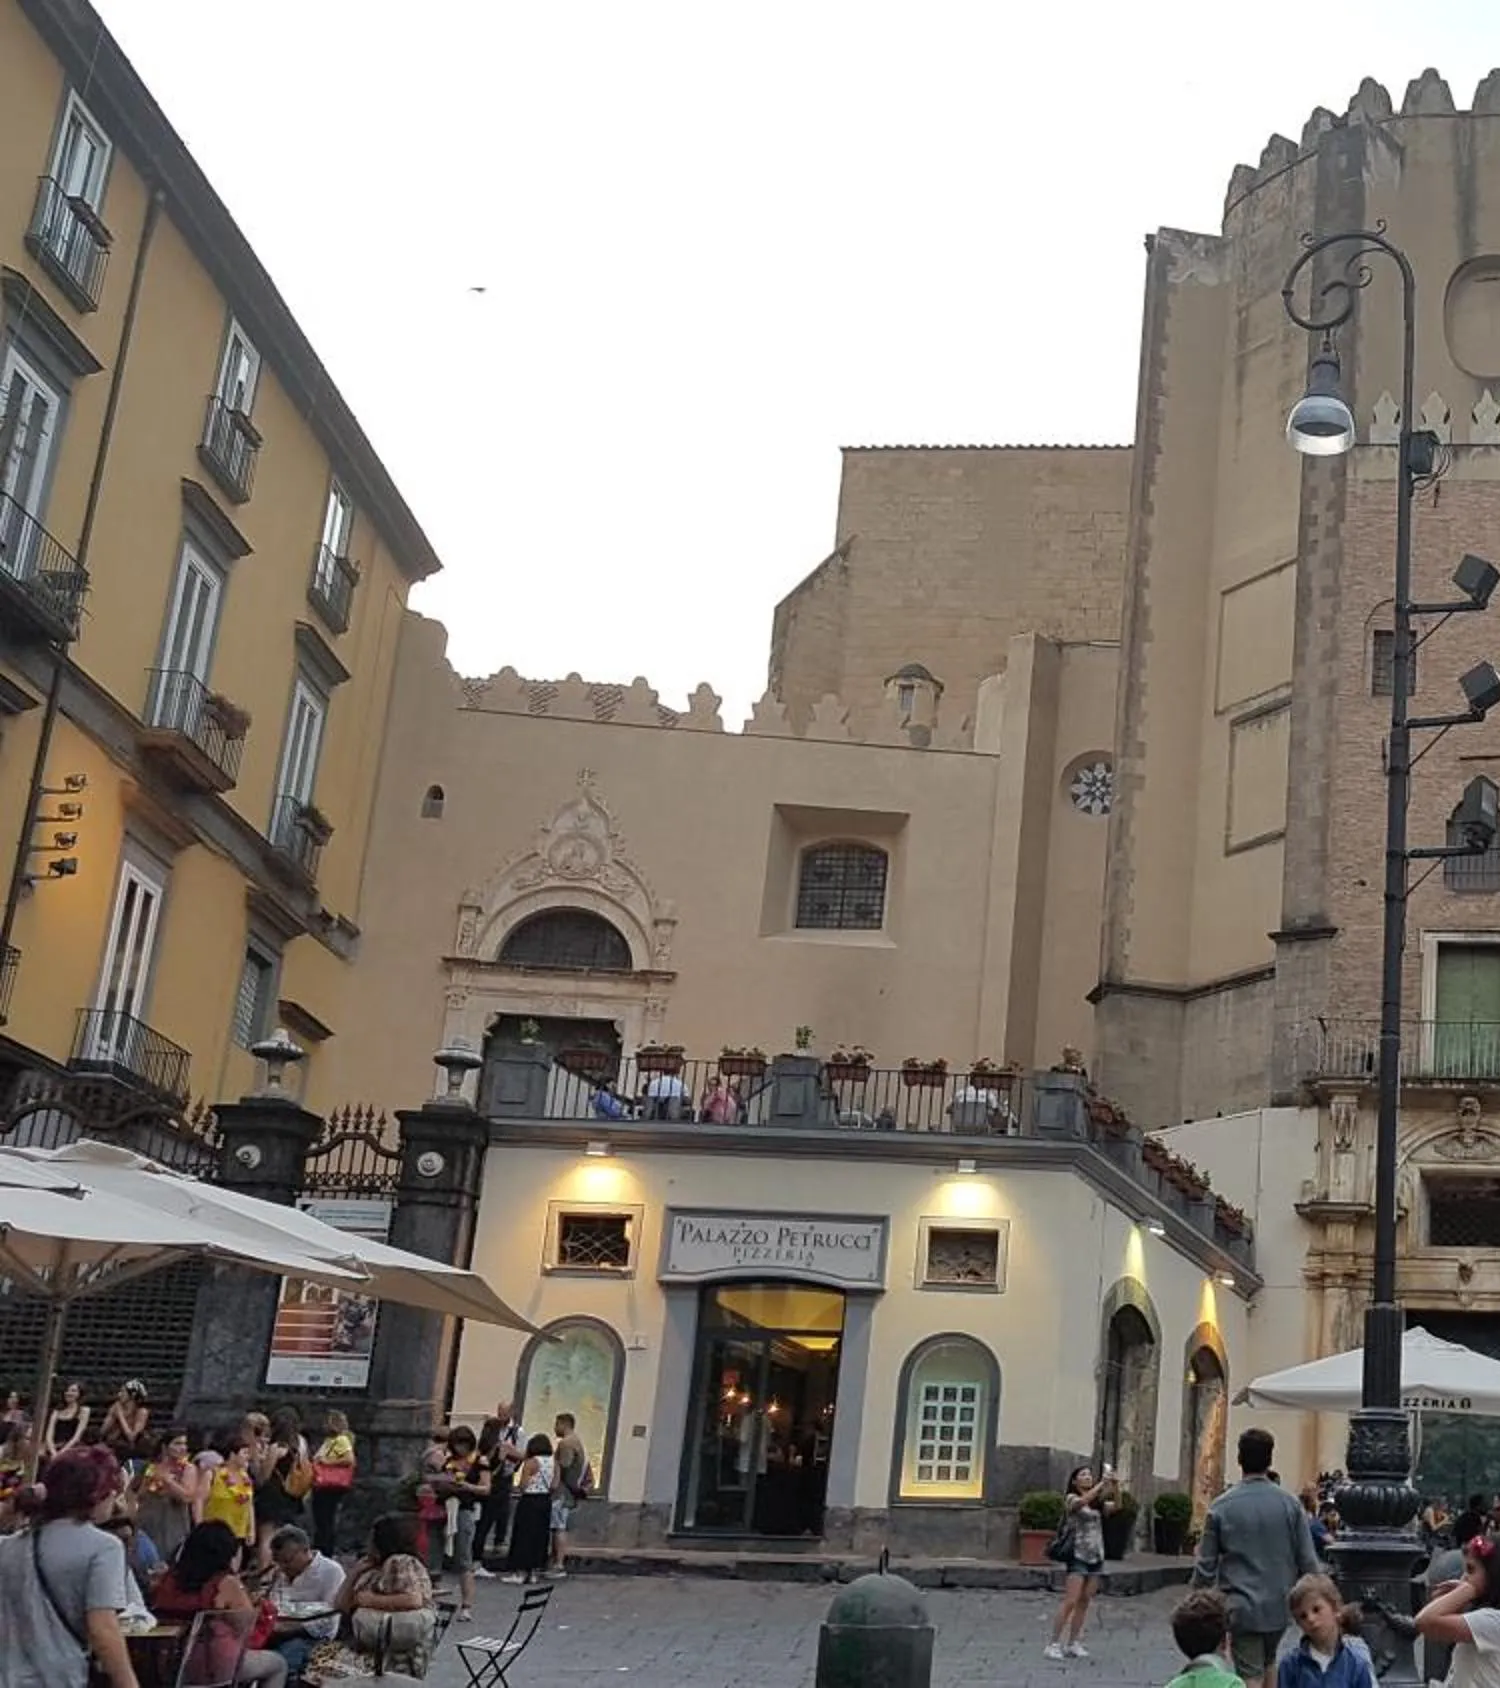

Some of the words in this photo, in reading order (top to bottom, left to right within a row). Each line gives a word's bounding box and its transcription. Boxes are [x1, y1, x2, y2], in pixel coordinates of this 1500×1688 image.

[680, 1221, 769, 1246] PALAZZO
[777, 1226, 872, 1250] PETRUCCI
[732, 1246, 816, 1262] PIZZERIA
[1402, 1396, 1456, 1409] ZZERIA
